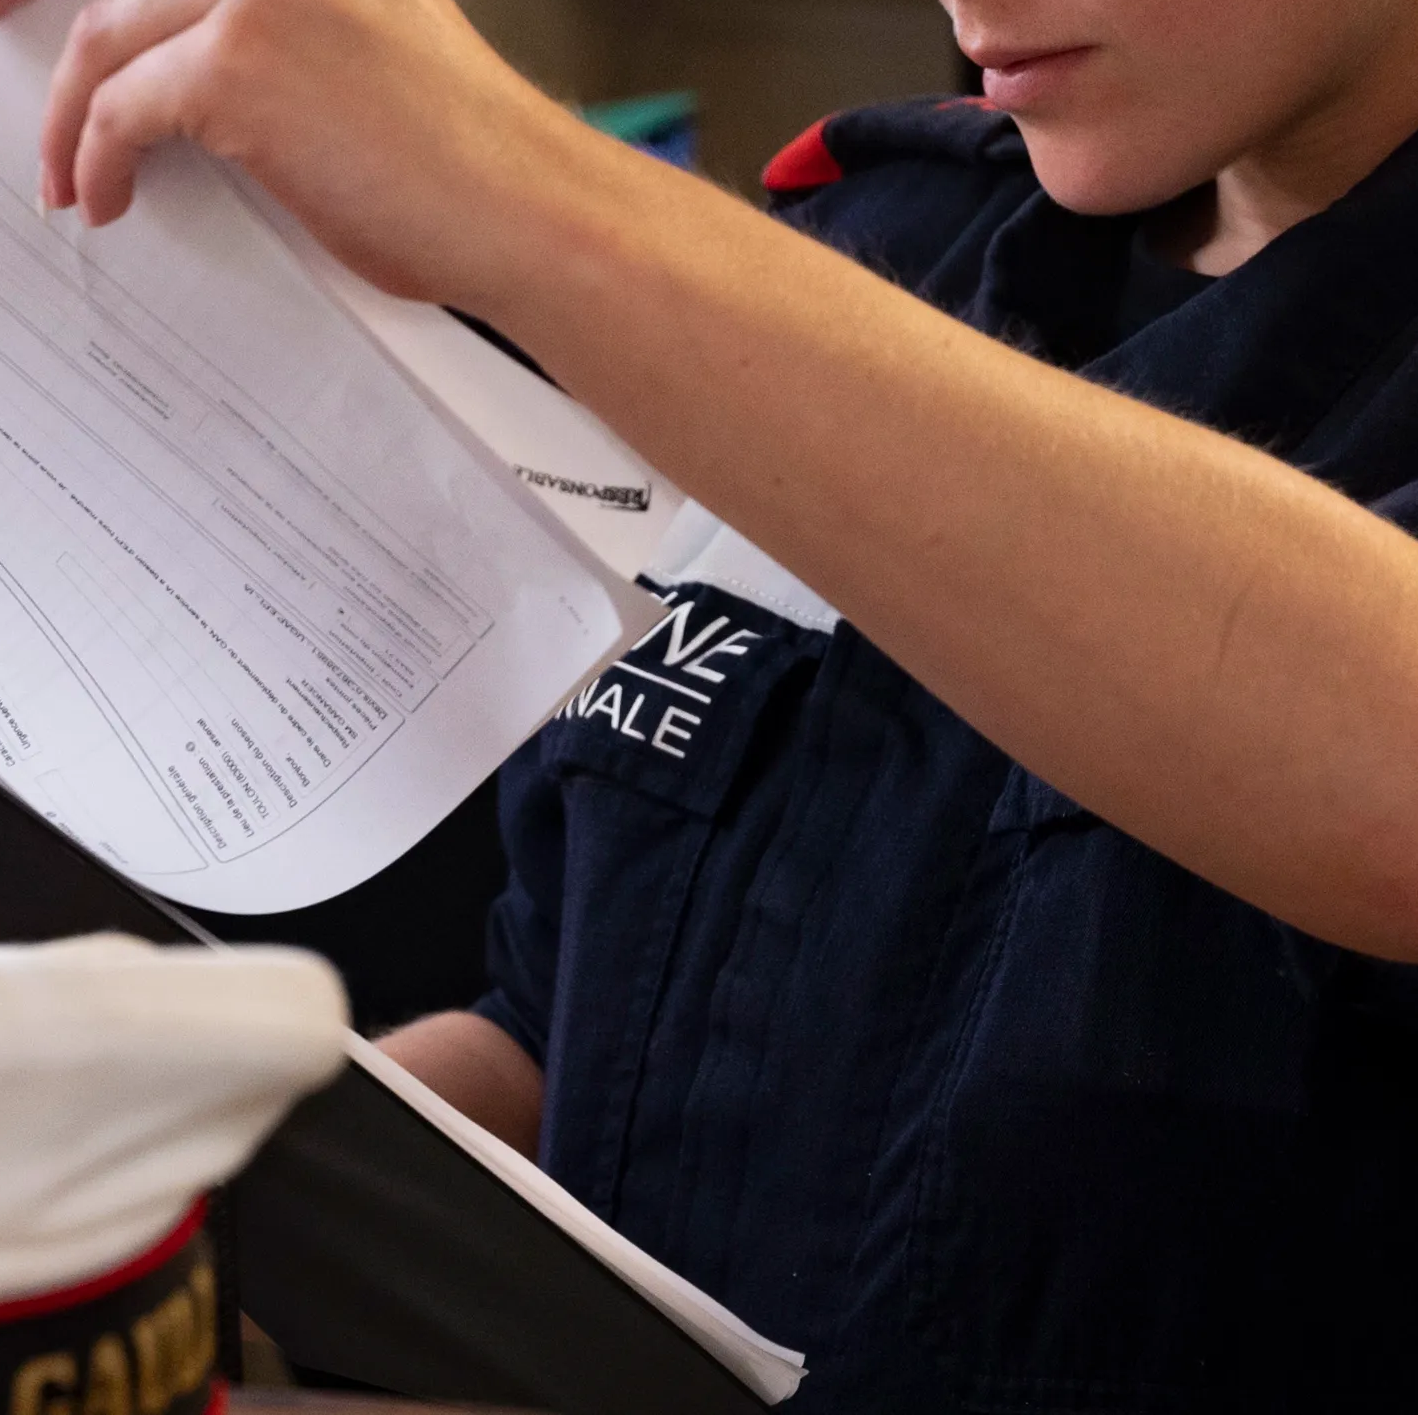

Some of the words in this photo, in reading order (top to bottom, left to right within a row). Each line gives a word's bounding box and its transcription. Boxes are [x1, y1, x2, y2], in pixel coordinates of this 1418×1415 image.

[631, 590, 763, 684] NE
[235, 657, 279, 704] déploiement
[276, 702, 289, 715] du
[286, 713, 308, 737] cadre
[350, 701, 378, 731] Pièces
[556, 678, 701, 758] NALE
[7, 717, 31, 750] Urgence
[195, 717, 222, 747] arsenal
[230, 717, 255, 750] besoin
[220, 750, 247, 784] (83000)
[251, 745, 264, 760] du
[283, 750, 311, 788] Bonjour,
[312, 743, 332, 768] Dans
[166, 764, 198, 804] générale
[197, 756, 232, 800] prestation
[260, 758, 298, 809] Description
[231, 807, 243, 820] de
[241, 781, 269, 819] TOULON
[191, 802, 228, 850] Description
[239, 817, 255, 838] Lieu
